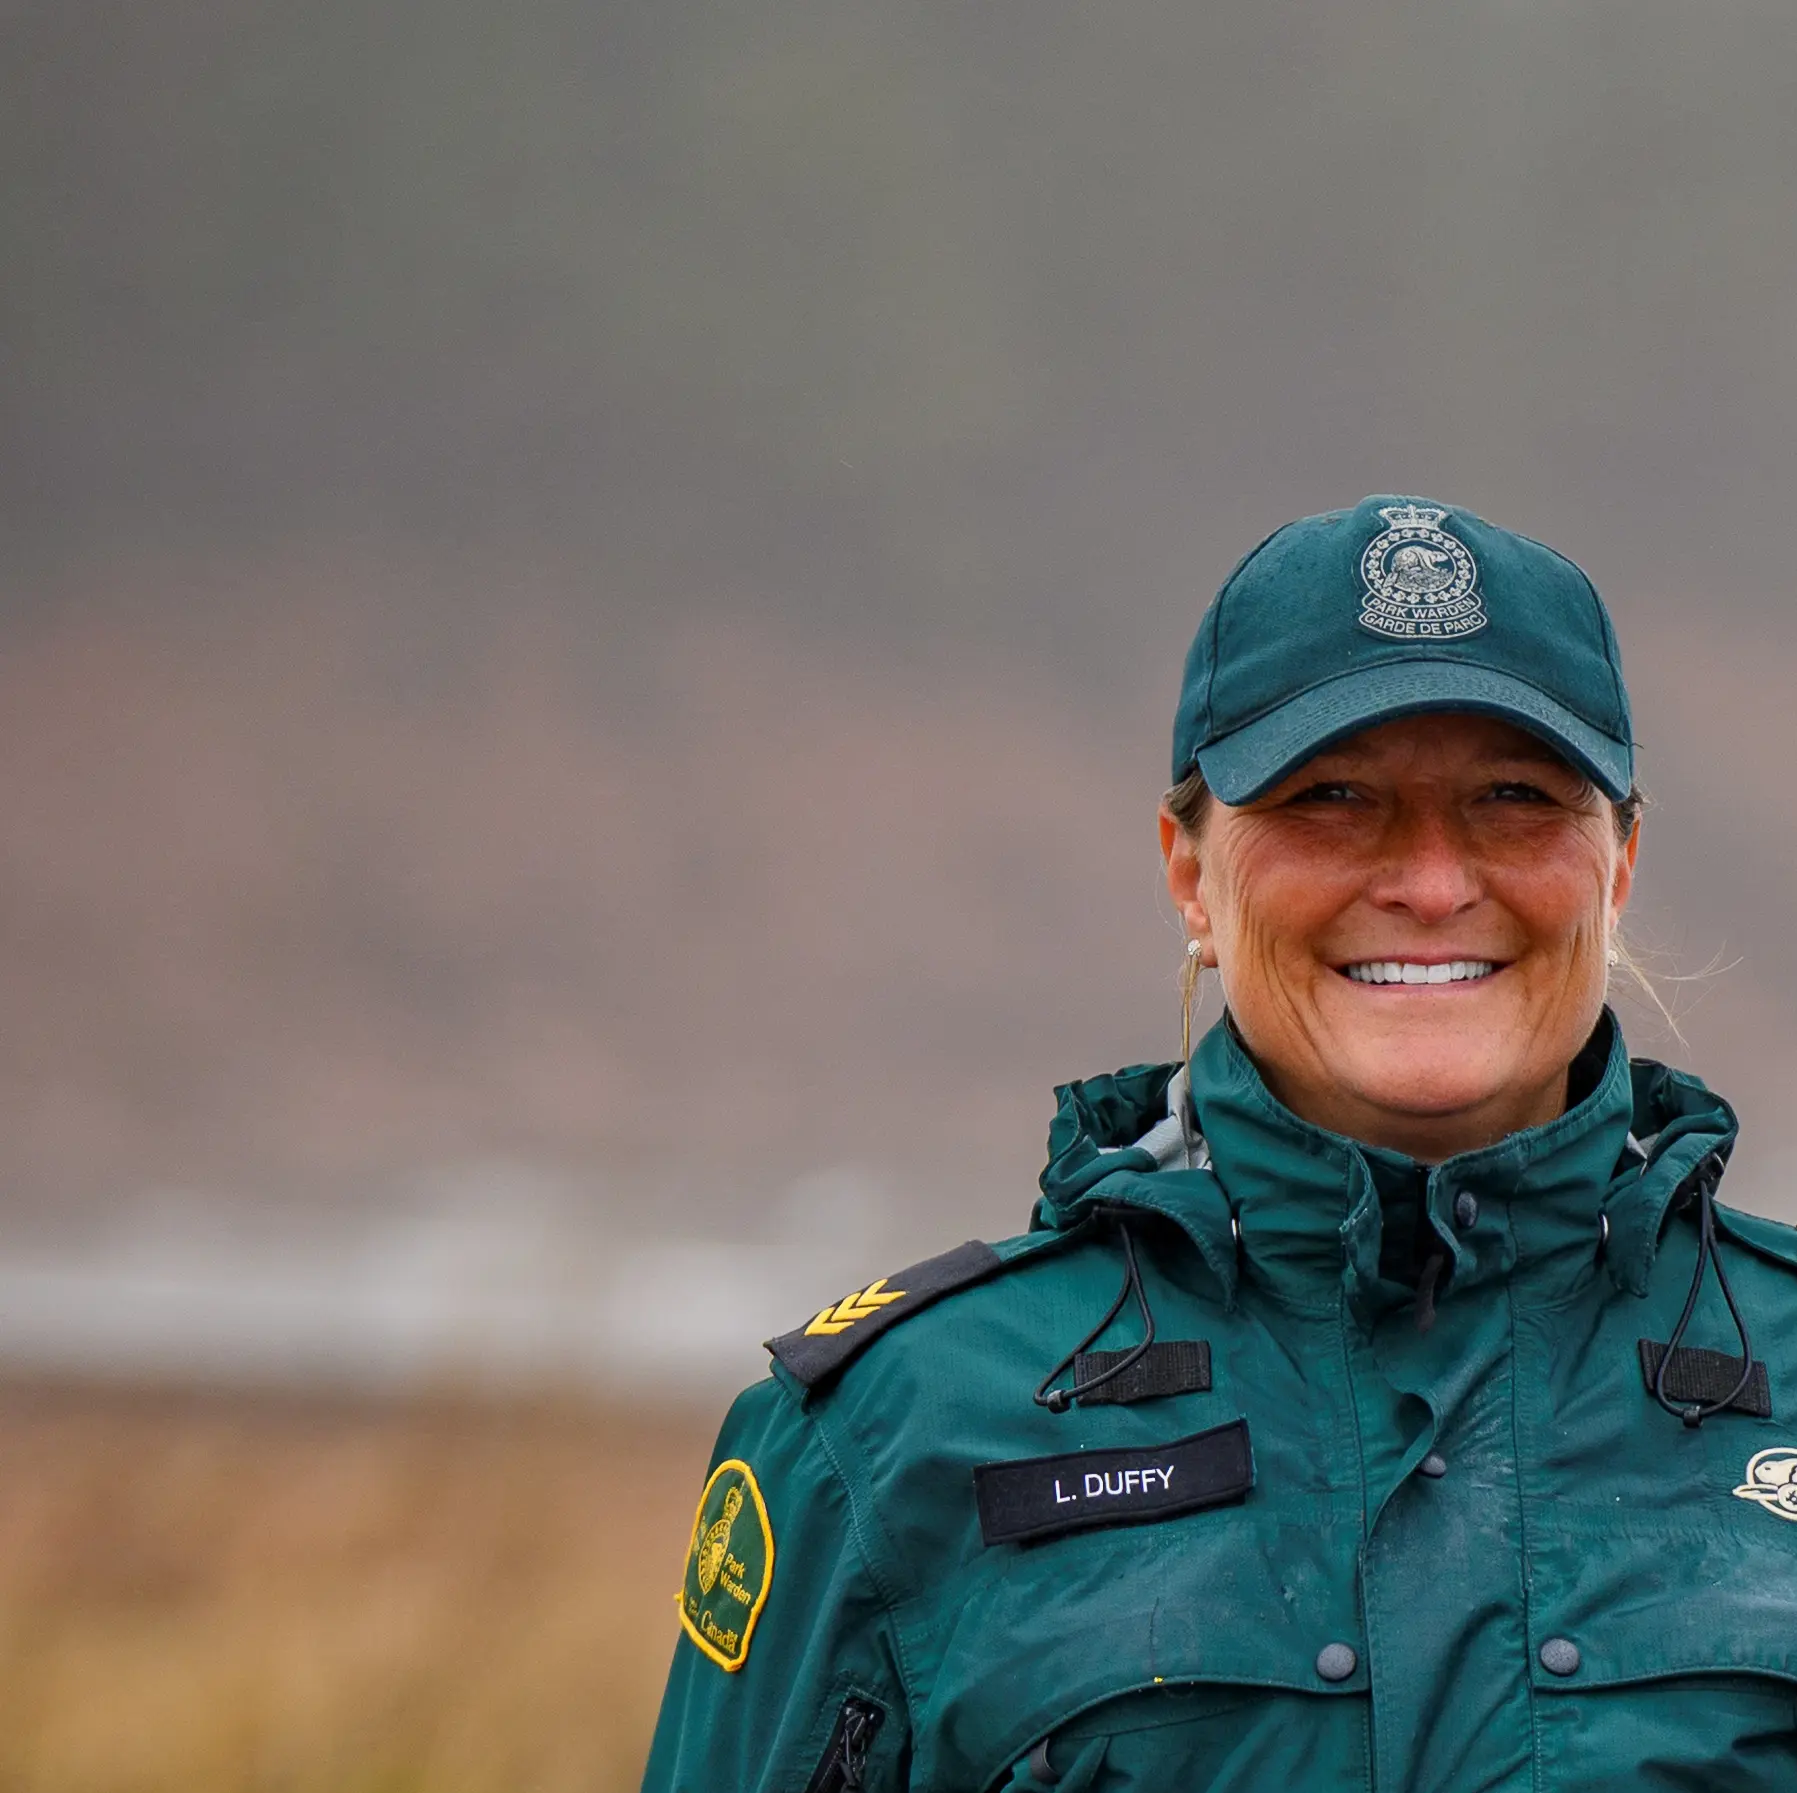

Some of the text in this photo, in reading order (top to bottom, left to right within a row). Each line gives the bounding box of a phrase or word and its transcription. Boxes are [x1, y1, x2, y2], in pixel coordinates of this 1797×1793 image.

[1364, 612, 1482, 635] GARDE DE PARC
[1367, 597, 1476, 619] PARK WARDEN
[1054, 1465, 1175, 1504] L. DUFFY
[725, 1552, 746, 1580] Park
[720, 1570, 751, 1605] Warden
[701, 1610, 737, 1655] Canada
